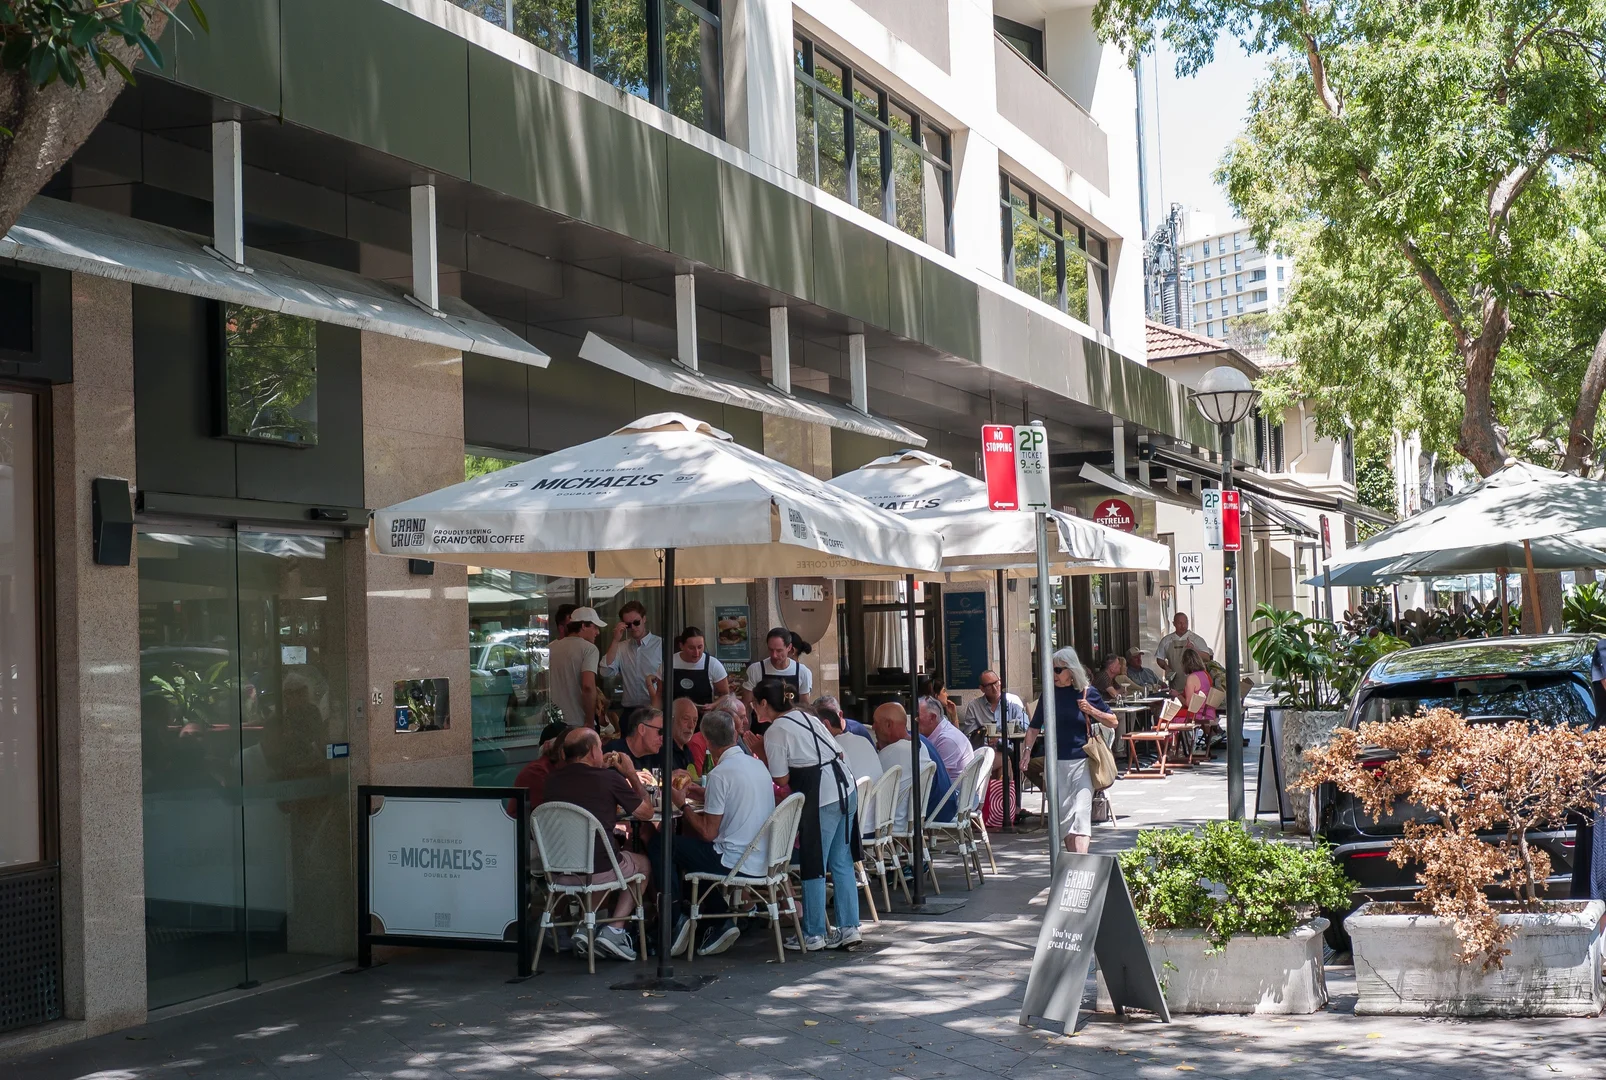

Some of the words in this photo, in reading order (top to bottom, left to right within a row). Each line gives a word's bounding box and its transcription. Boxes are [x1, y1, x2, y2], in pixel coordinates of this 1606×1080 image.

[993, 430, 1004, 441] NO
[1019, 431, 1044, 451] 2P
[986, 442, 1013, 452] STOPPING
[530, 473, 664, 491] MICHAEL'S
[1204, 493, 1219, 508] 2P
[391, 518, 426, 532] GRAND
[391, 533, 411, 547] CRU
[489, 534, 525, 544] COFFEE
[1182, 555, 1199, 563] ONE
[1181, 565, 1200, 573] WAY
[371, 693, 383, 704] 45
[388, 853, 398, 861] 19
[401, 847, 483, 871] MICHAEL'S
[485, 857, 497, 866] 99
[1065, 869, 1095, 890] GRAND
[1061, 887, 1081, 907] CRU
[1052, 927, 1072, 940] You've
[1071, 932, 1083, 942] got
[1047, 940, 1064, 950] great
[1064, 941, 1081, 952] taste.
